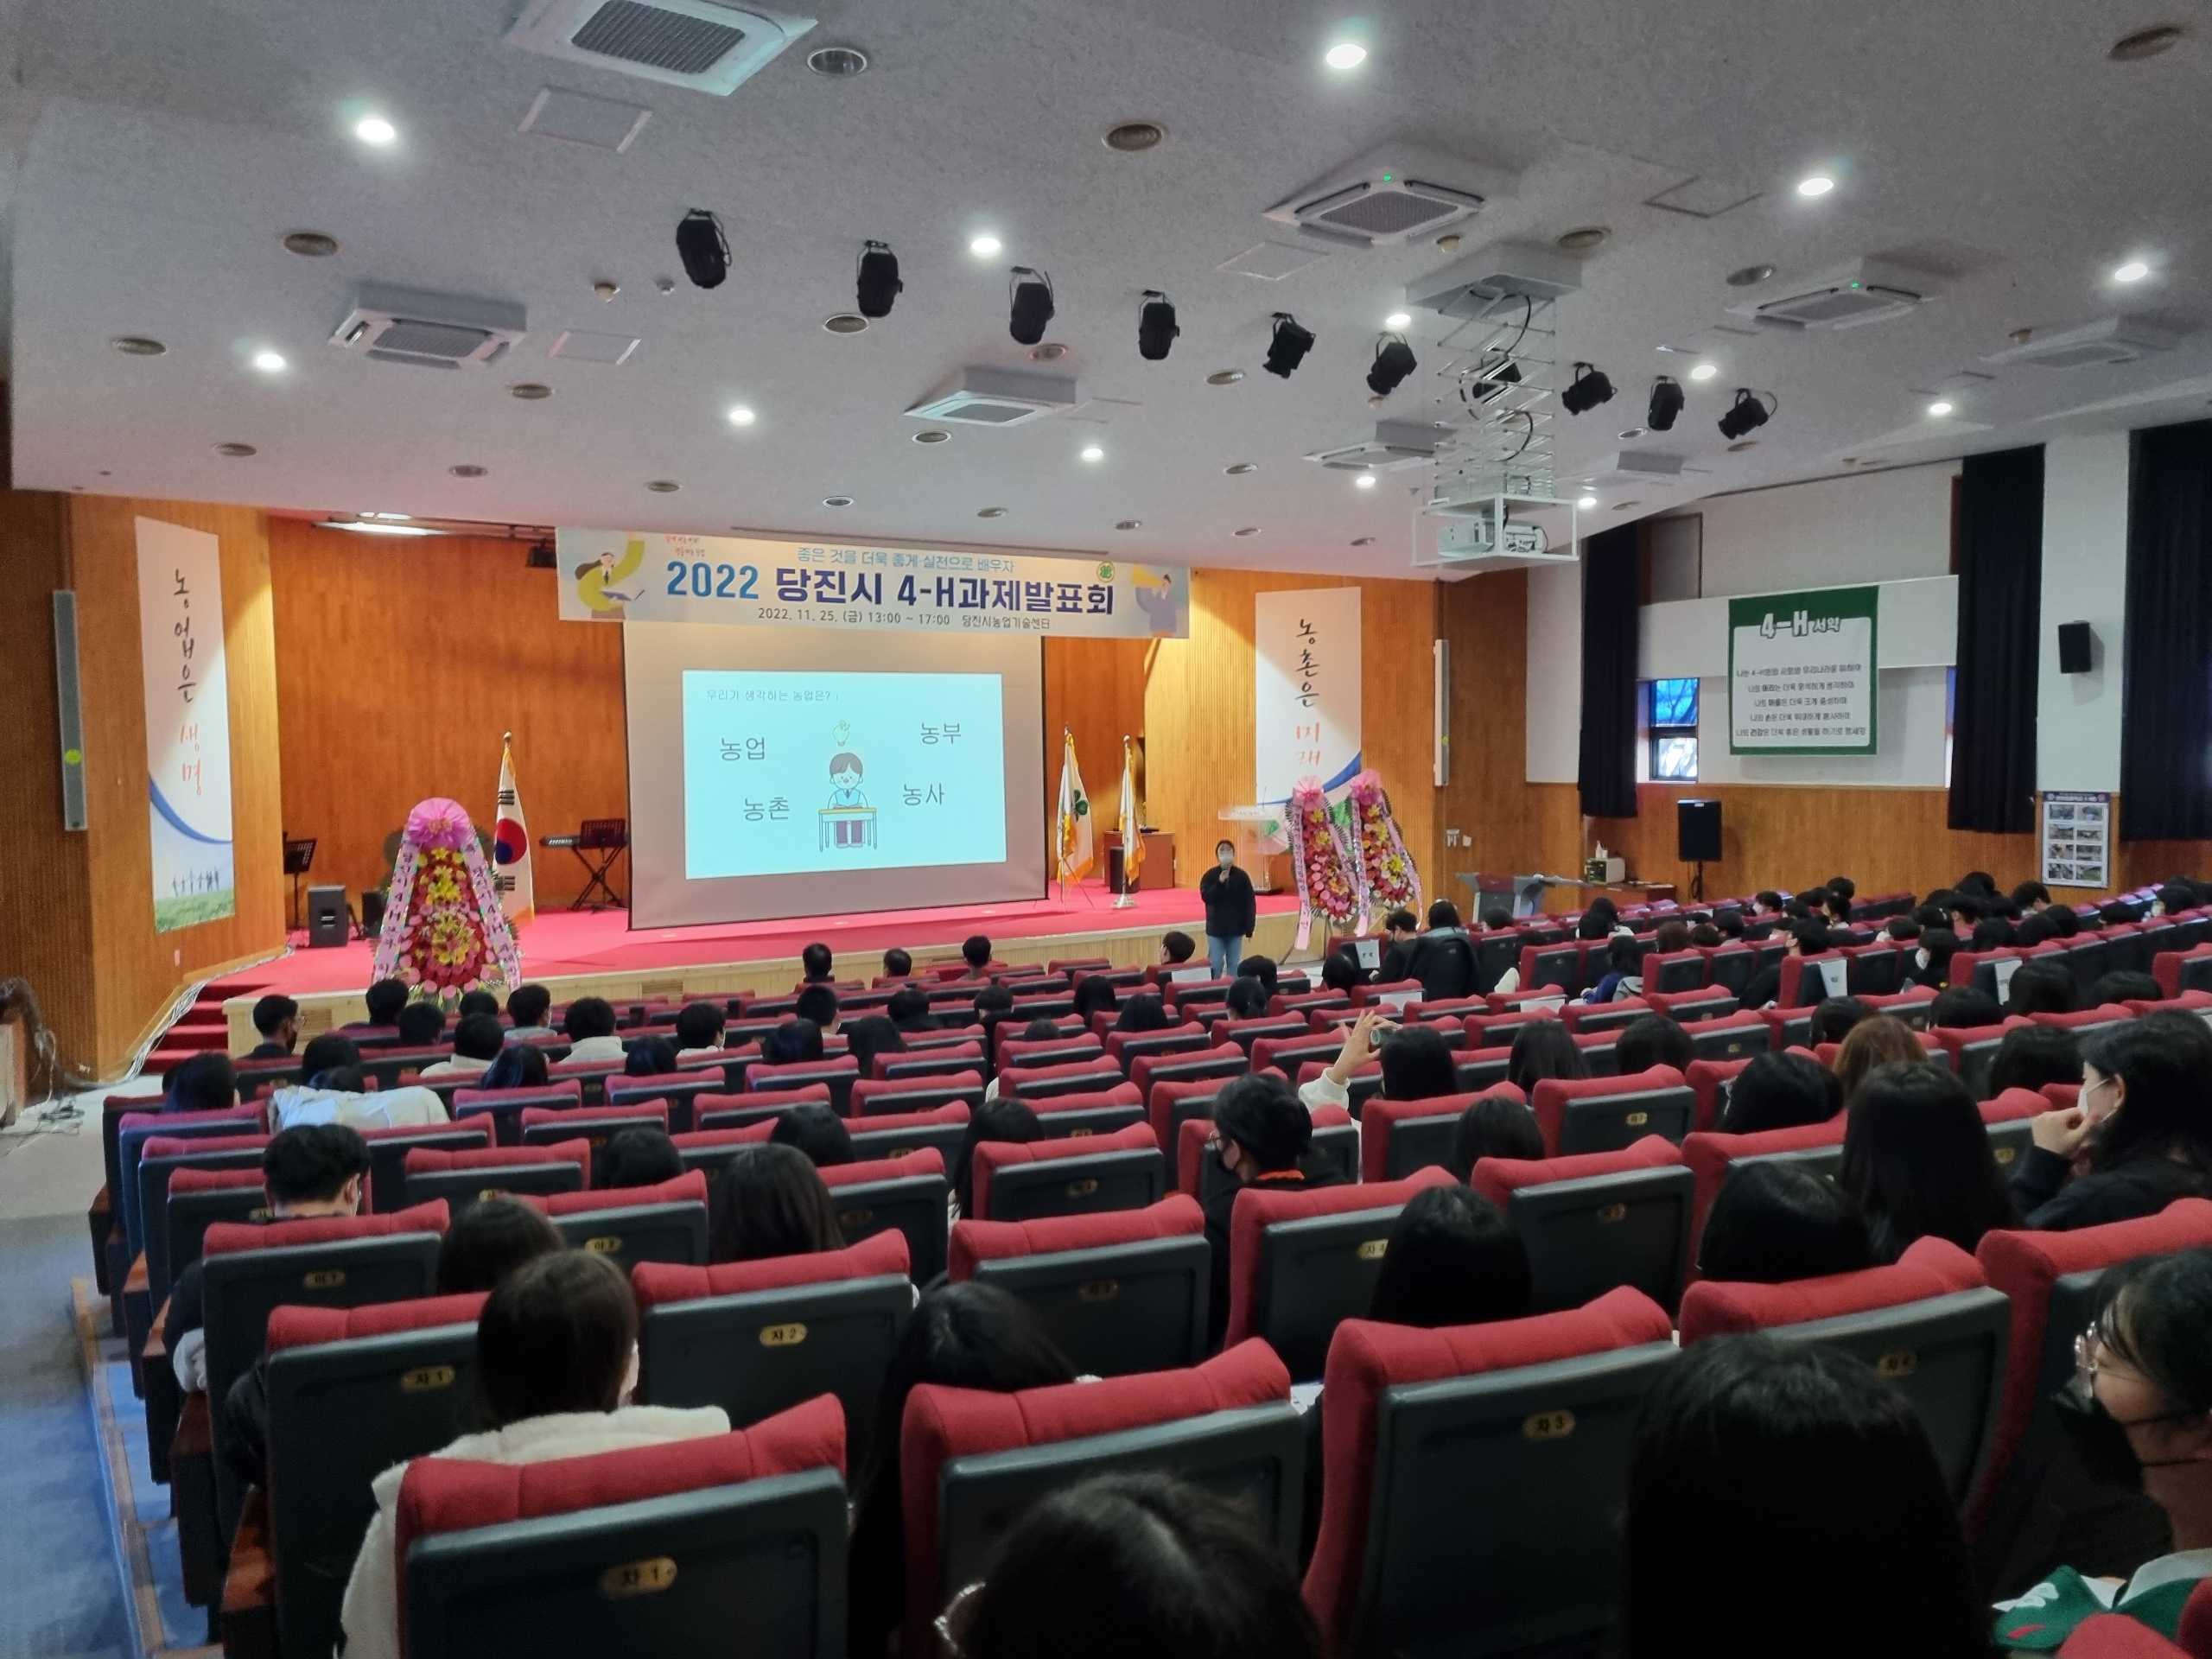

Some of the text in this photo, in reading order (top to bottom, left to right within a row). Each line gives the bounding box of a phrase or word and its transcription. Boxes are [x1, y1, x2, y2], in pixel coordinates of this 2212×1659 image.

[798, 547, 1014, 574] 좋은 것을 더욱 좋게 실천으로 배우자
[666, 561, 1114, 615] 2022 당진시 4-H과제발표회
[758, 607, 792, 620] 2022.
[797, 609, 816, 621] 11.
[820, 610, 838, 622] 25.
[843, 610, 862, 623] (금)
[868, 612, 901, 624] 13:00
[918, 614, 950, 625] 17:00
[962, 614, 1051, 629] 당진시농업기술센터
[1760, 610, 1808, 639] 4-H
[174, 568, 196, 703] 농업은
[1294, 619, 1320, 708] 농촌은
[707, 690, 830, 701] 우리가 생각하는 농업은?
[919, 721, 963, 745] 농부
[1295, 722, 1321, 766] 미래
[180, 724, 202, 796] 생명
[719, 737, 766, 761] 농업
[902, 783, 945, 806] 농사
[742, 796, 791, 822] 농촌
[790, 1327, 797, 1338] 2
[1555, 1414, 1563, 1430] 3
